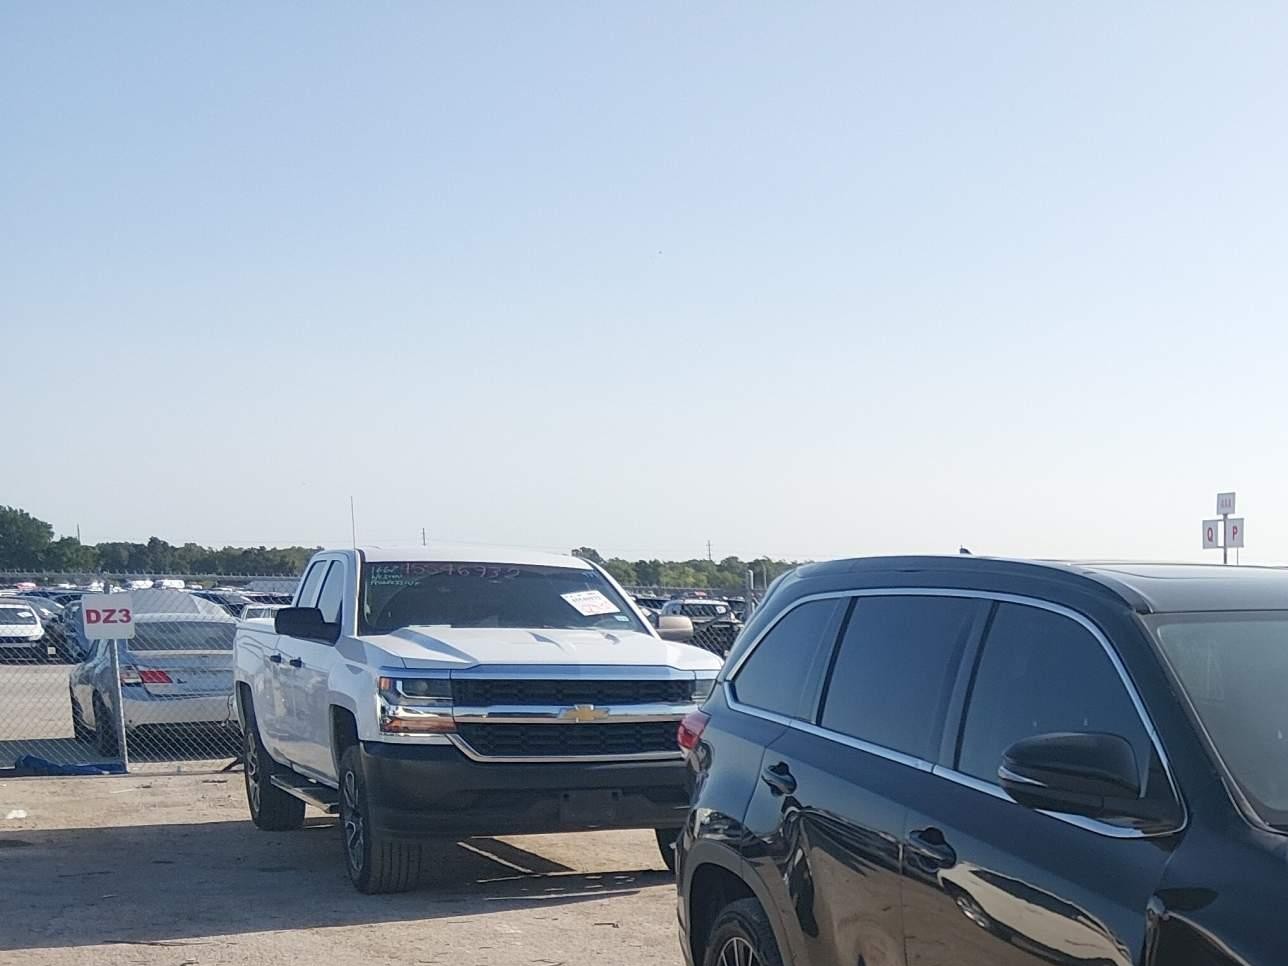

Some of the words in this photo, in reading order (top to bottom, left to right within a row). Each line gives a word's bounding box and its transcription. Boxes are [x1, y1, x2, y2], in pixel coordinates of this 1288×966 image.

[1207, 527, 1213, 542] Q
[1232, 525, 1238, 541] P
[85, 608, 132, 624] DZ3
